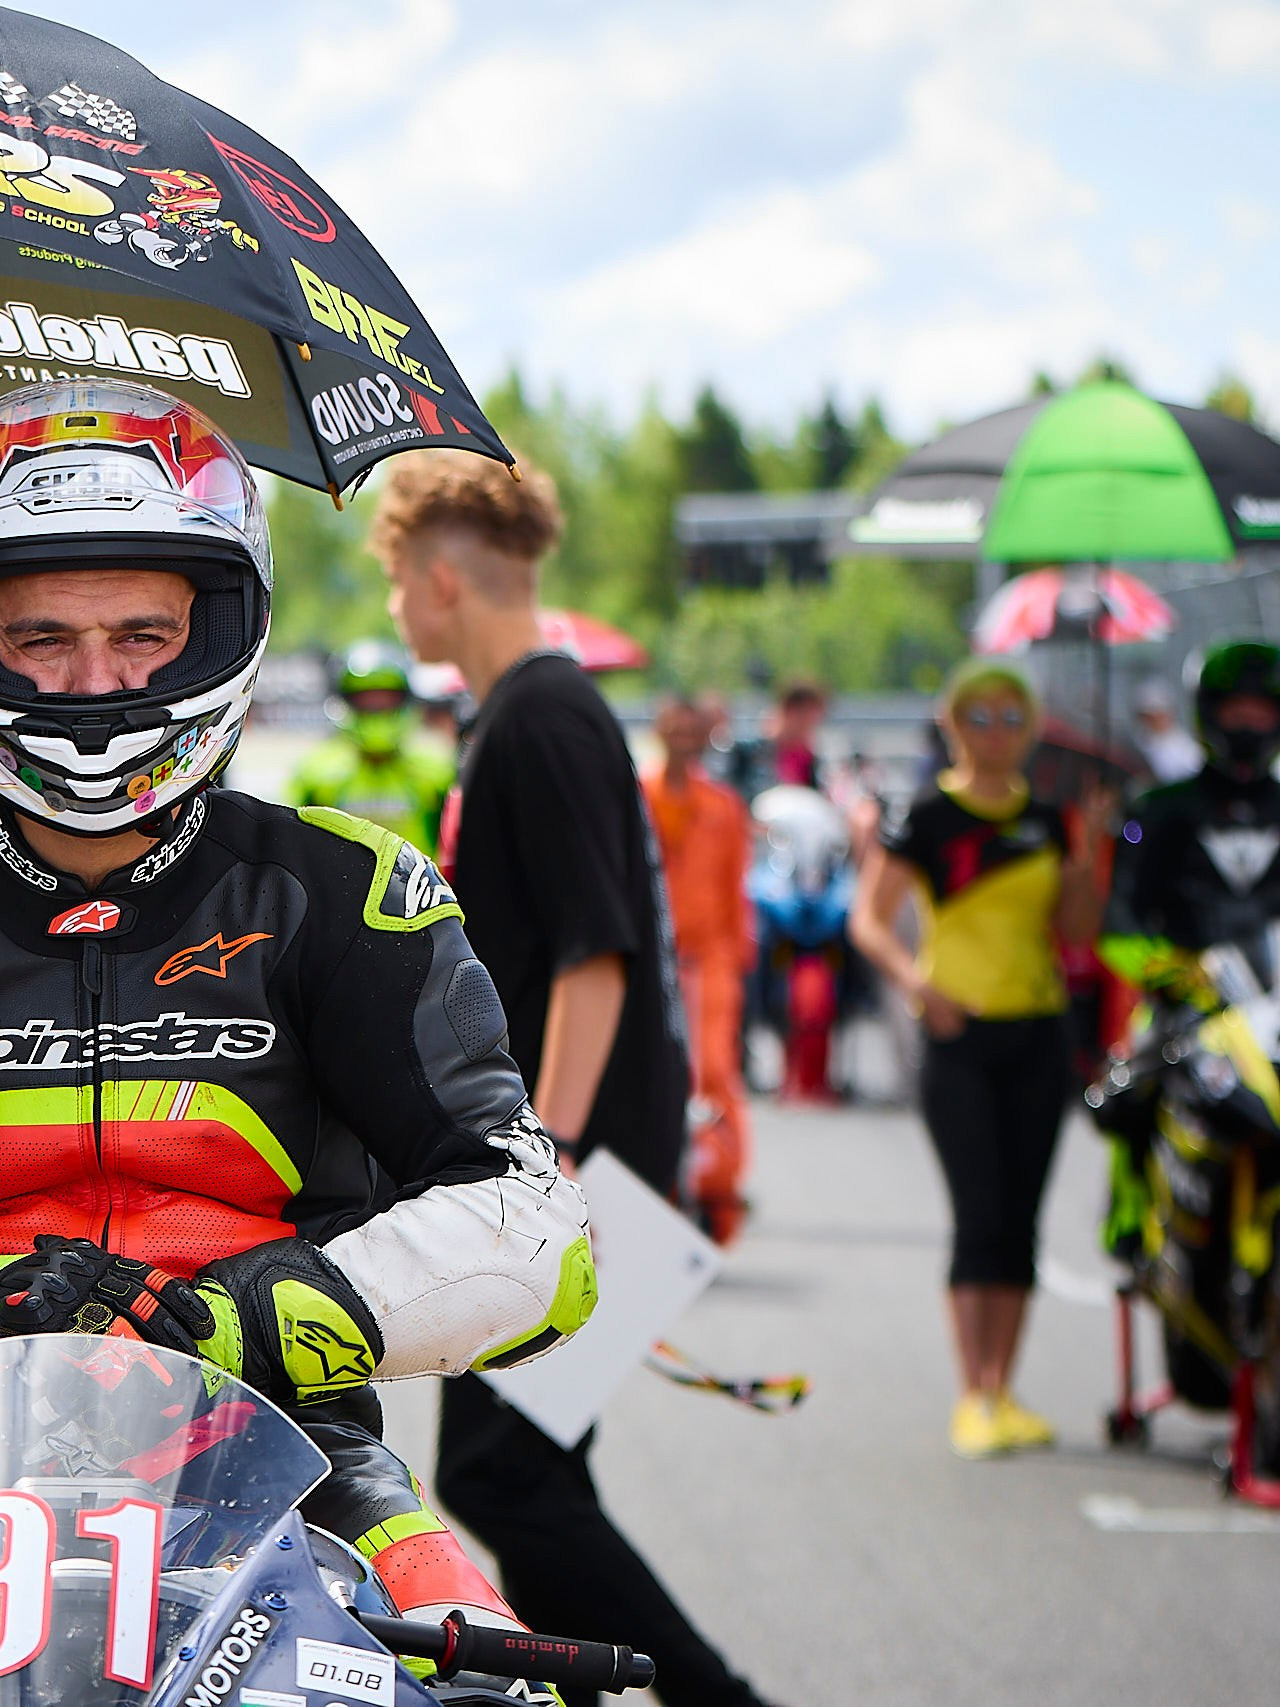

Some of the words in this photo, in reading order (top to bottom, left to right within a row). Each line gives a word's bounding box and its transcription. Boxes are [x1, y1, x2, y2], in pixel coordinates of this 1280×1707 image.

[43, 125, 146, 156] RACING
[11, 205, 92, 237] SCHOOL
[185, 1608, 270, 1707] MOTORS
[505, 1638, 579, 1665] domino
[310, 1662, 382, 1690] 01.08
